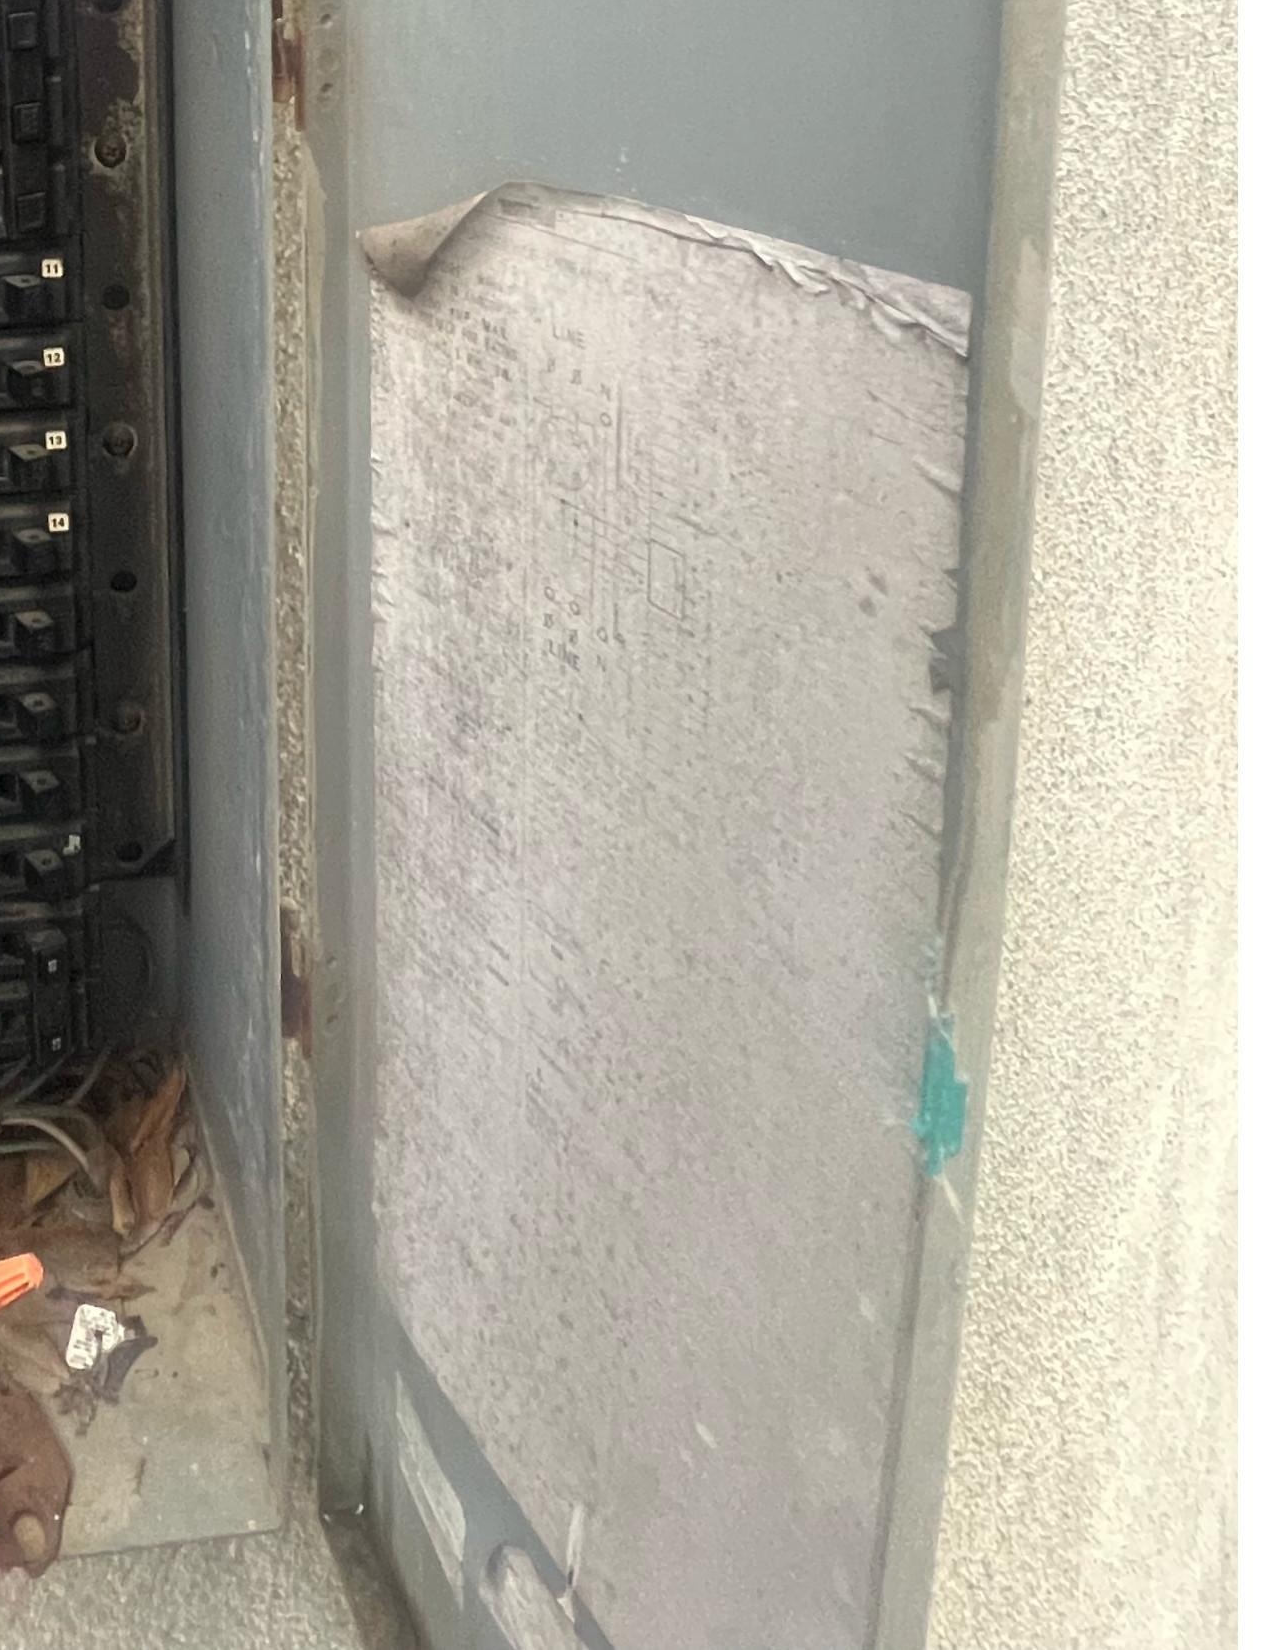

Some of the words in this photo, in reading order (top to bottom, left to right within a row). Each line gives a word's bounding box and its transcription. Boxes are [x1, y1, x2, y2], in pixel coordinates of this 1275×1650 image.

[45, 263, 60, 274] 11
[47, 352, 61, 363] 12
[49, 436, 63, 446] 13
[51, 518, 66, 528] 14
